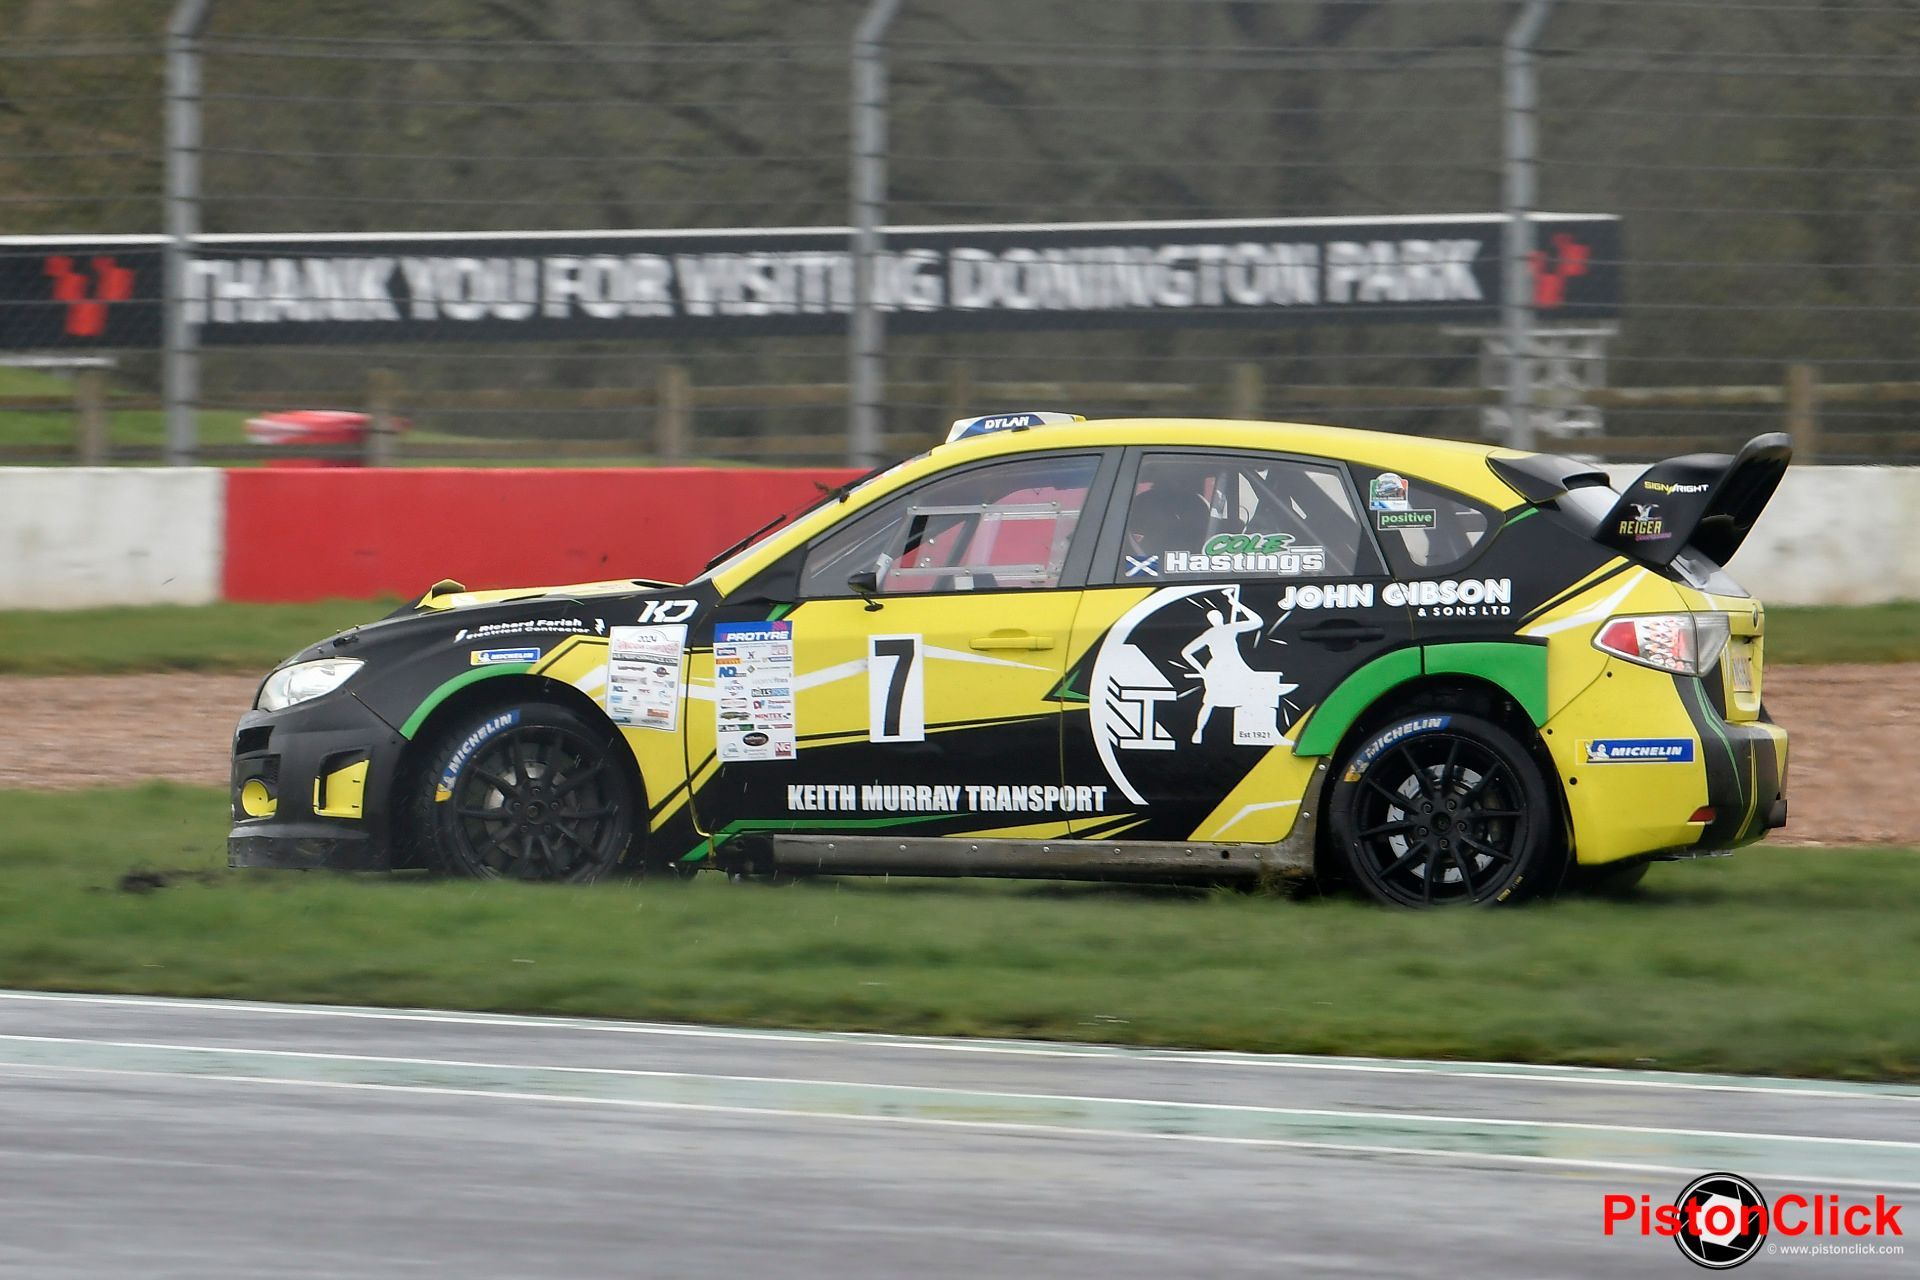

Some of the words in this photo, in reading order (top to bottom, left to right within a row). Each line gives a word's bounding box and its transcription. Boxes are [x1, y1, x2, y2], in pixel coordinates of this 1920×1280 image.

[186, 257, 400, 323] THANK
[401, 256, 539, 320] YOU
[543, 253, 675, 319] FOR
[949, 241, 1320, 311] DONINGTON
[1326, 239, 1484, 304] PARK
[984, 415, 1030, 430] DYLAN
[1381, 512, 1433, 526] positive
[1619, 520, 1662, 534] REIGER
[1203, 533, 1295, 556] COLE
[1165, 551, 1326, 576] Hastings
[1278, 584, 1375, 611] JOHN
[1382, 579, 1512, 608] GIBSON
[1417, 607, 1428, 617] &
[1432, 606, 1477, 617] SONS
[1481, 605, 1512, 616] LTD
[726, 631, 790, 642] PROTYRE
[874, 638, 915, 737] 7
[449, 713, 513, 774] MICHELIN
[1239, 730, 1251, 739] Est
[1364, 717, 1443, 760] MICHELIN
[1610, 746, 1683, 757] MICHELIN
[787, 784, 857, 812] KEITH
[860, 784, 962, 812] MURRAY
[965, 785, 1108, 812] TRANSPORT
